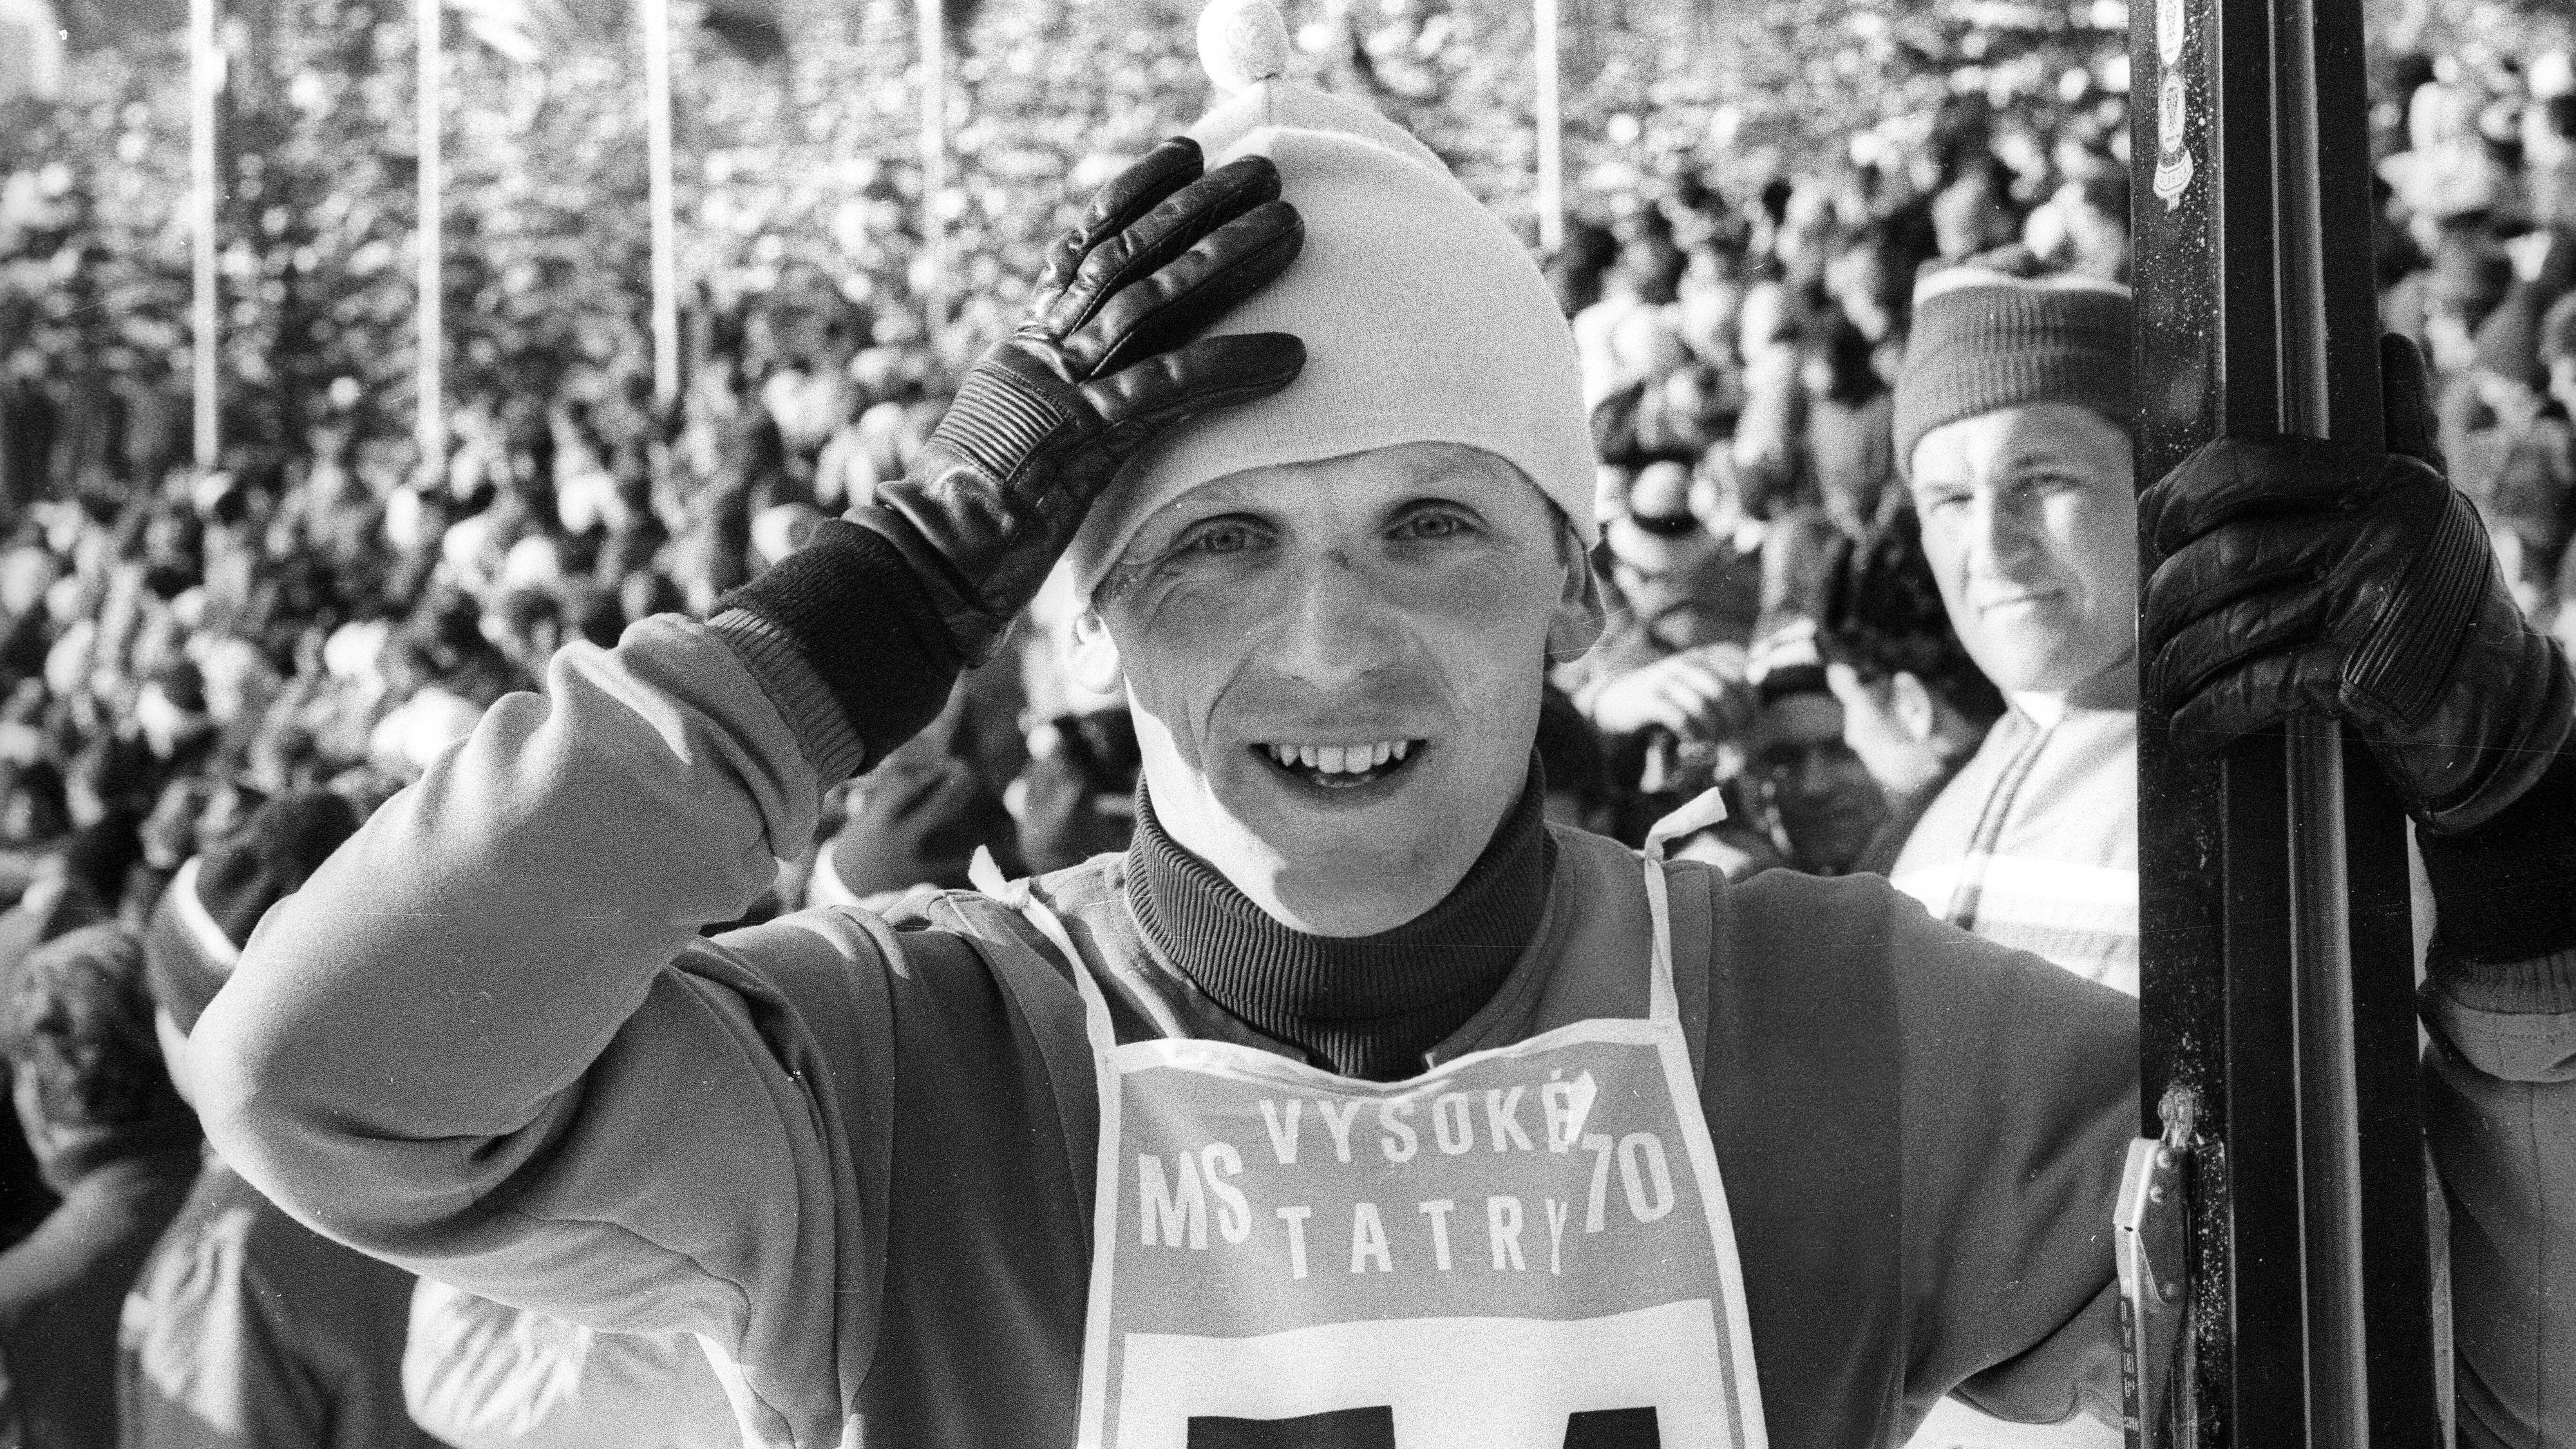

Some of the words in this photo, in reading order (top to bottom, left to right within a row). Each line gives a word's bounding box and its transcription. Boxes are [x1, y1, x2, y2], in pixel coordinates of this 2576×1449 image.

[1260, 1070, 1592, 1164] VYSOKÉ
[1139, 1141, 1251, 1249] MS
[1582, 1132, 1674, 1233] 70
[1276, 1196, 1567, 1280] TATRY
